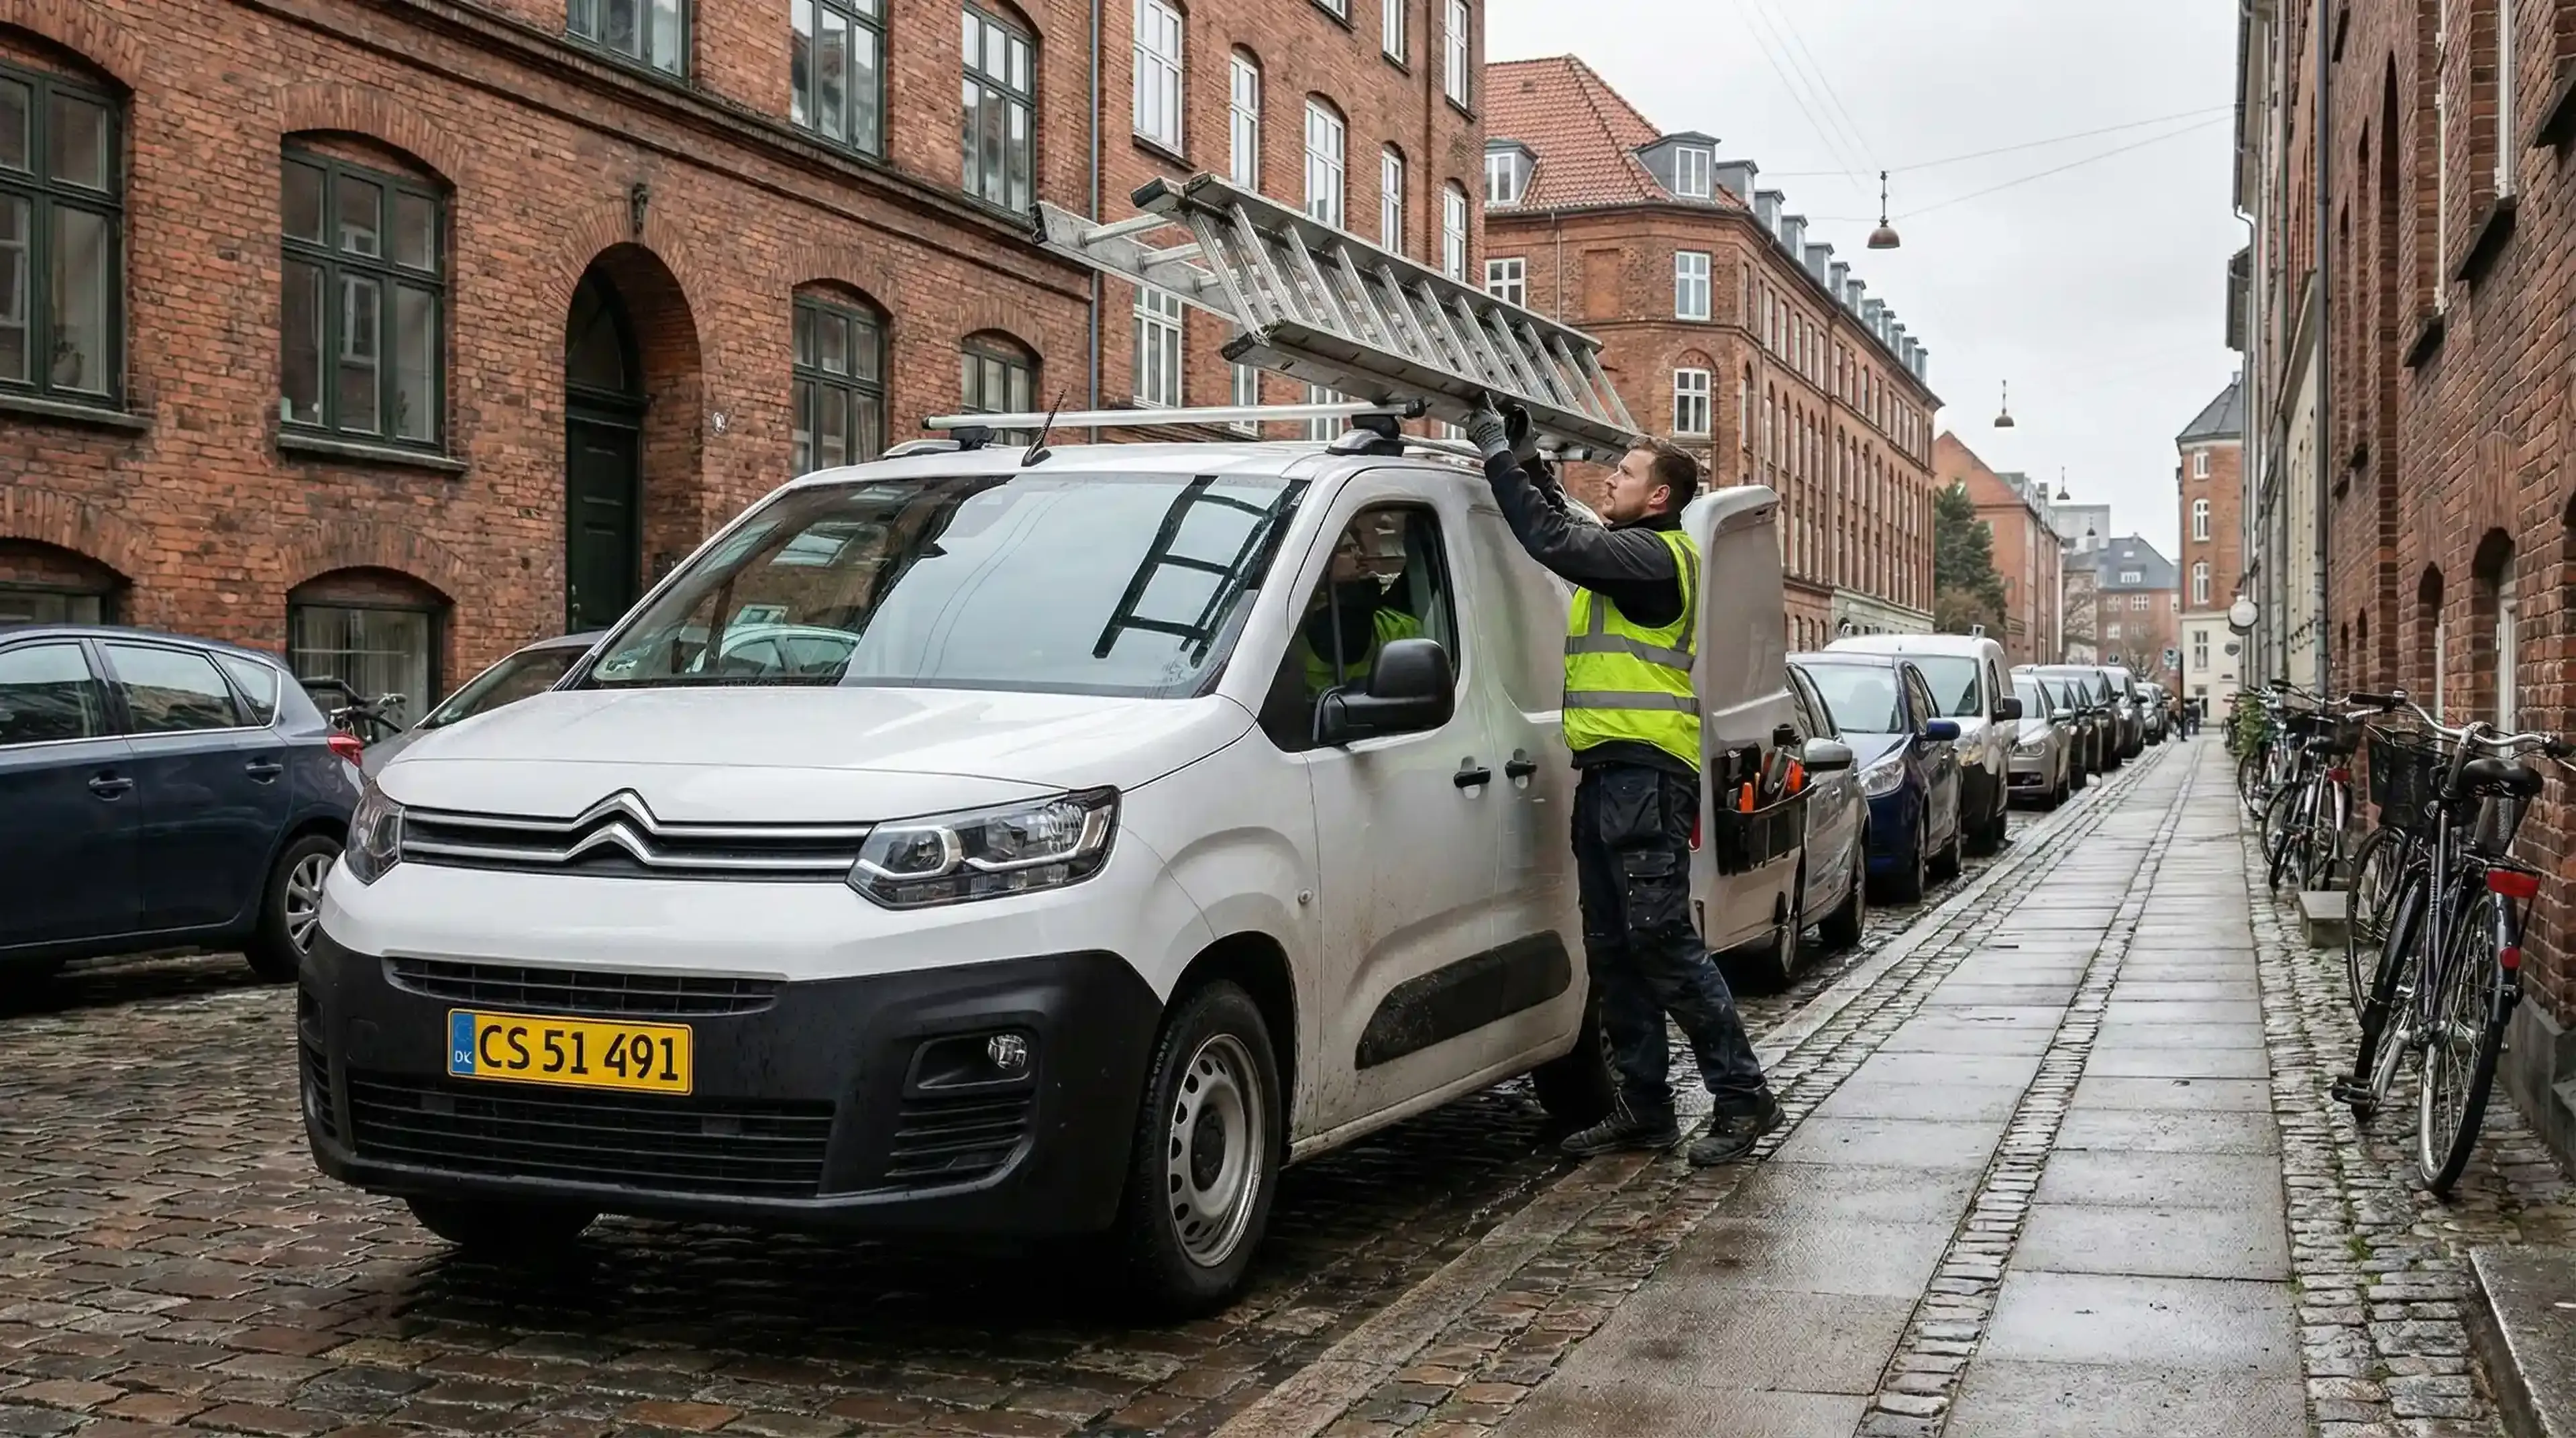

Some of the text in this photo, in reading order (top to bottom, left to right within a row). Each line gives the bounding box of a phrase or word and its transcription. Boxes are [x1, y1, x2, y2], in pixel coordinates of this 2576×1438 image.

[455, 1050, 472, 1064] DK
[480, 1024, 678, 1081] CS 51 491
